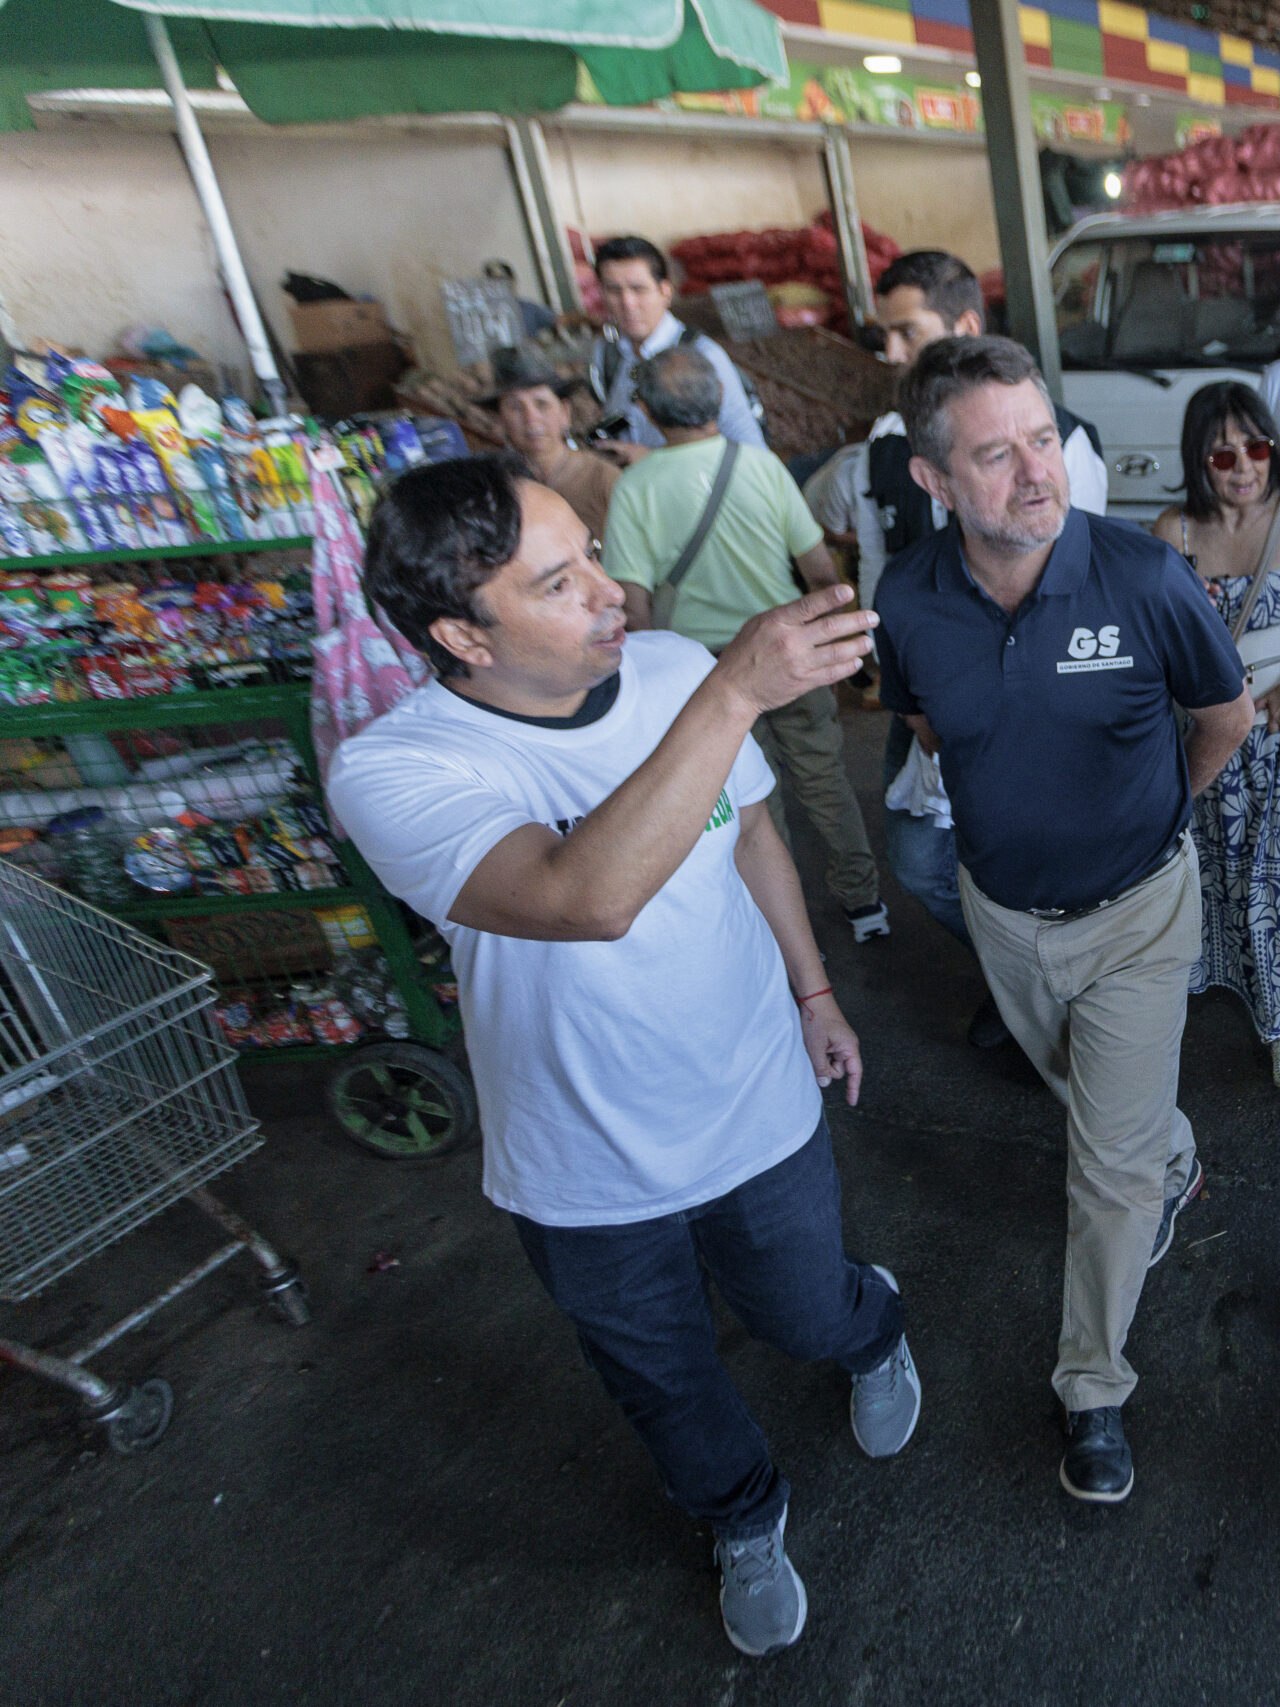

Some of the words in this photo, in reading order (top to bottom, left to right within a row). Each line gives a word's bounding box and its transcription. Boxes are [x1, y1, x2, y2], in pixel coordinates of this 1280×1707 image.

[1067, 625, 1120, 660] GS
[1059, 663, 1091, 671] GOBIERNO
[1102, 659, 1131, 667] SANTIAGO
